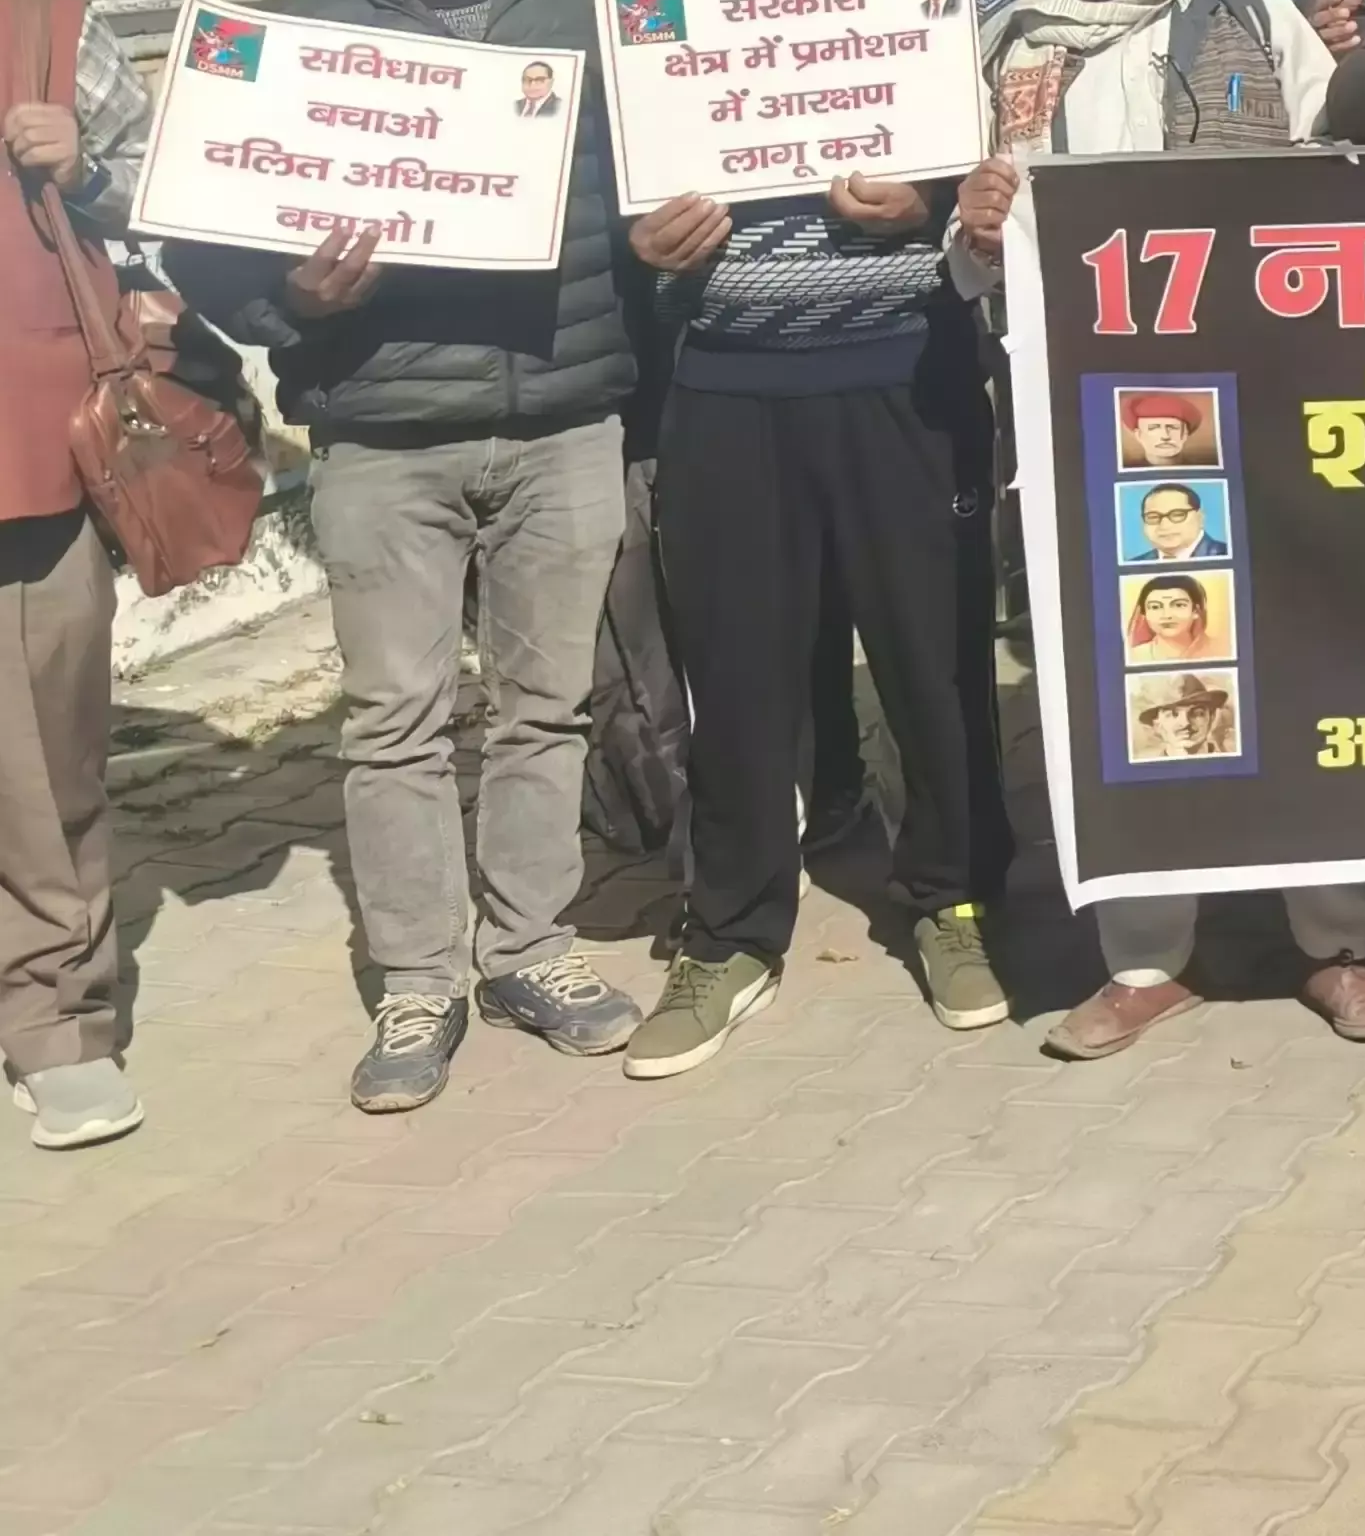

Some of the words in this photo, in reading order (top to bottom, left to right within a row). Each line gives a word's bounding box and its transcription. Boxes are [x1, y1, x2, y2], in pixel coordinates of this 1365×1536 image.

[632, 30, 676, 44] DSMM
[664, 44, 731, 77] क्षेत्र
[743, 34, 784, 70] में
[790, 28, 930, 73] प्रमोशन
[197, 61, 245, 79] DSMM
[307, 100, 444, 140] बचाओ
[708, 88, 751, 123] में
[756, 82, 896, 120] आरक्षण
[204, 138, 335, 182] दलित
[343, 158, 519, 198] अधिकार
[720, 141, 818, 177] लागू
[818, 124, 895, 161] करो
[1082, 227, 1216, 335] 17
